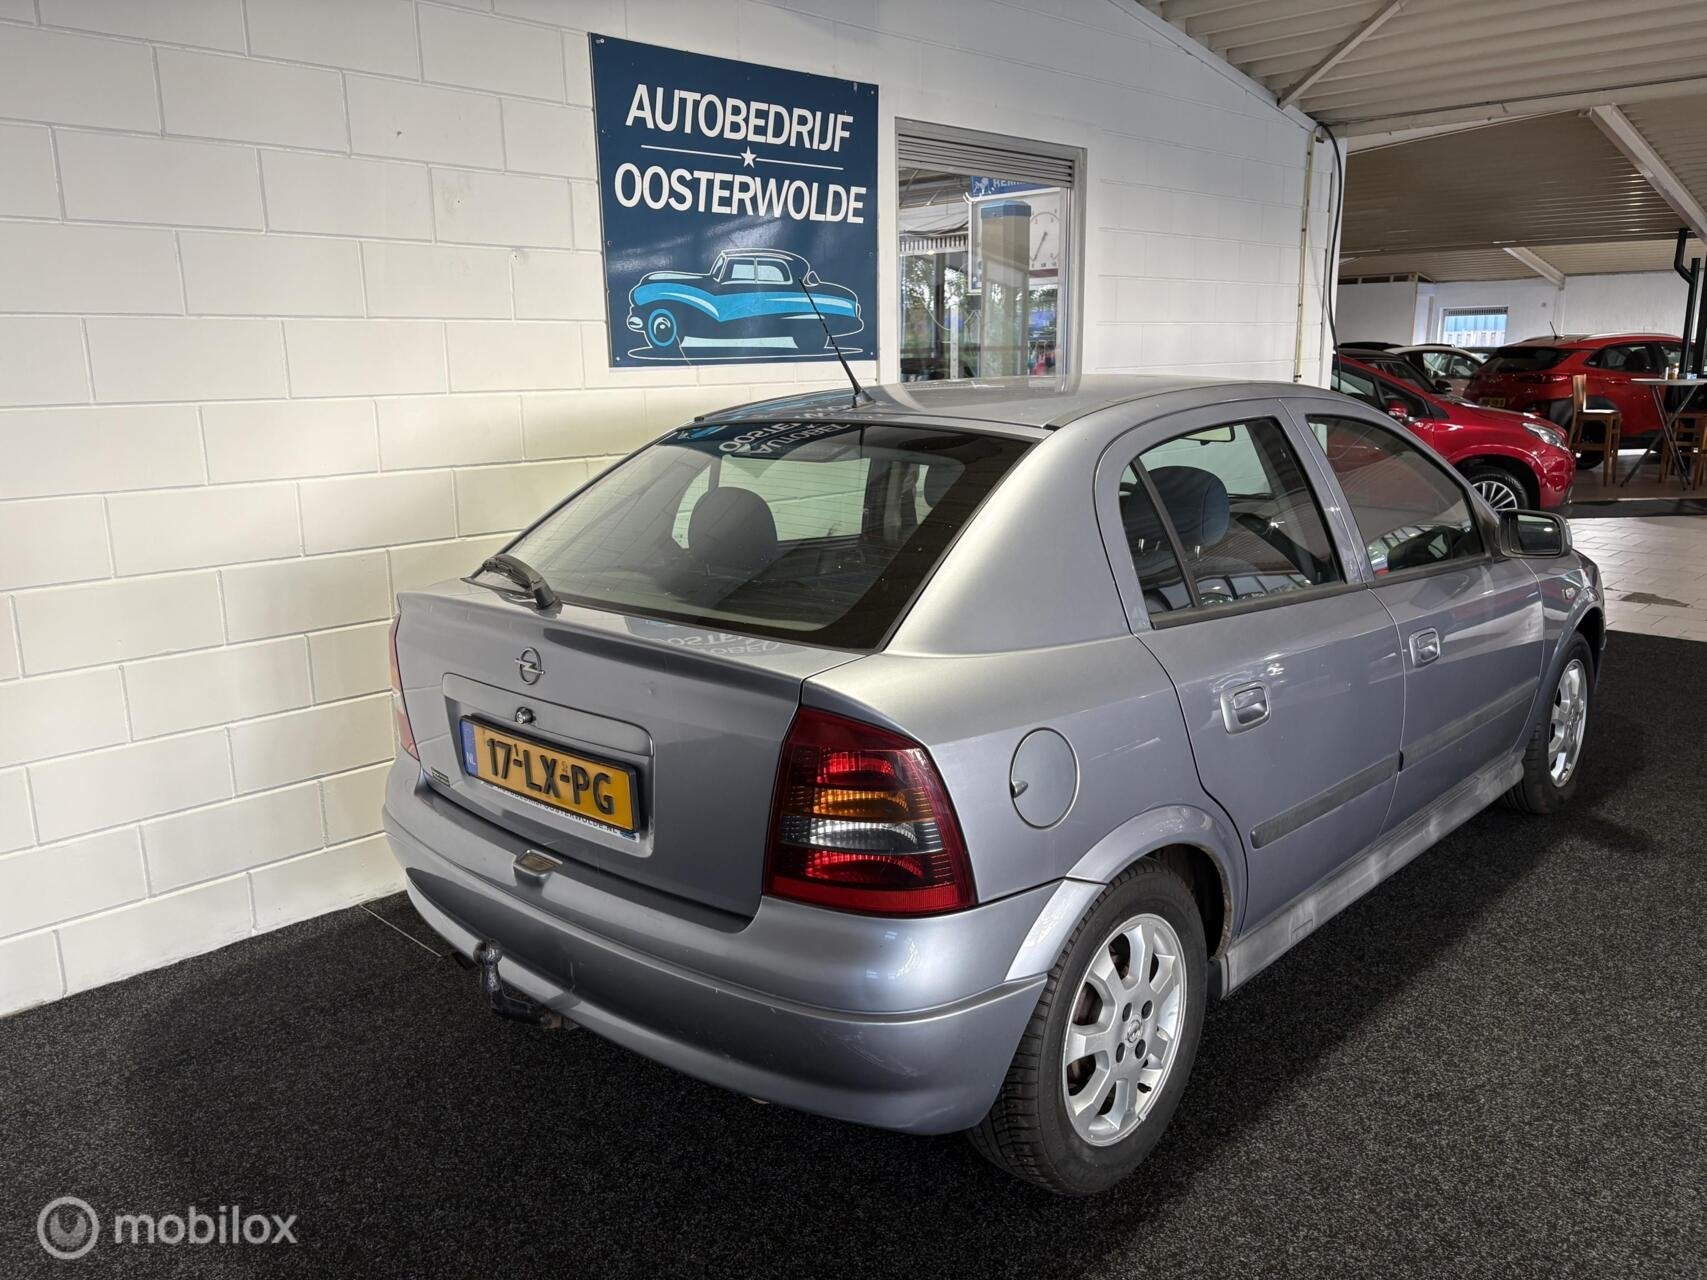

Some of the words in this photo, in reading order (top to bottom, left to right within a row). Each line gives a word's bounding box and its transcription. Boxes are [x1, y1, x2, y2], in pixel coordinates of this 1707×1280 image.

[625, 84, 853, 152] AUTOBEDRIJF
[614, 162, 867, 223] OOSTERWOLDE
[487, 738, 614, 816] 17-LX-PG
